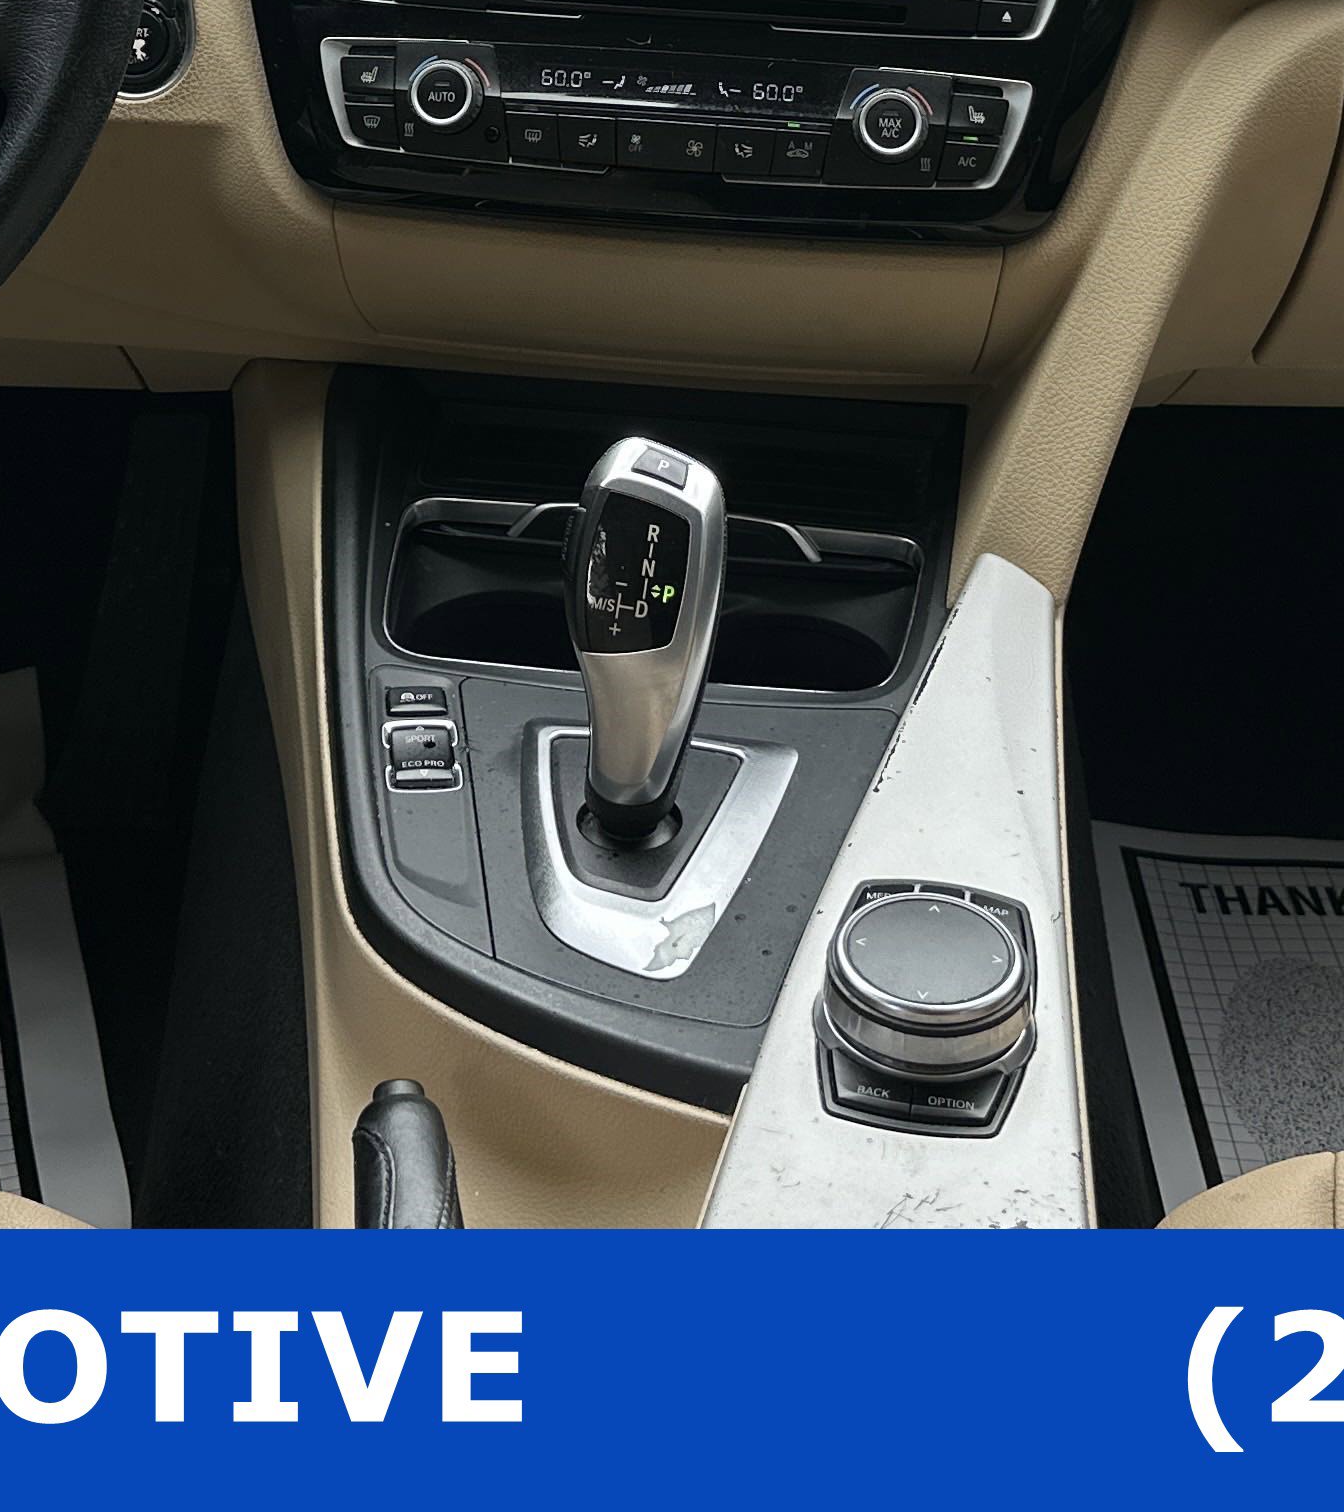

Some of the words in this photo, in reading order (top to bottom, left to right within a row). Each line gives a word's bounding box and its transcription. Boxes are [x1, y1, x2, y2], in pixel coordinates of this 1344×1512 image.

[428, 91, 456, 103] AUTO
[878, 118, 901, 130] MAX
[881, 128, 900, 139] A/C
[788, 141, 795, 150] A
[805, 142, 813, 151] M
[958, 156, 976, 168] A/C
[658, 459, 670, 471] P
[647, 524, 660, 543] R
[641, 559, 656, 577] N
[662, 585, 675, 604] P
[591, 598, 615, 612] M/S
[634, 600, 648, 619] D
[405, 734, 436, 744] SPORT
[402, 760, 422, 768] ECO
[424, 759, 445, 767] PRO
[983, 904, 1009, 916] MAP
[857, 1085, 891, 1098] BACK
[928, 1095, 976, 1111] OPTION
